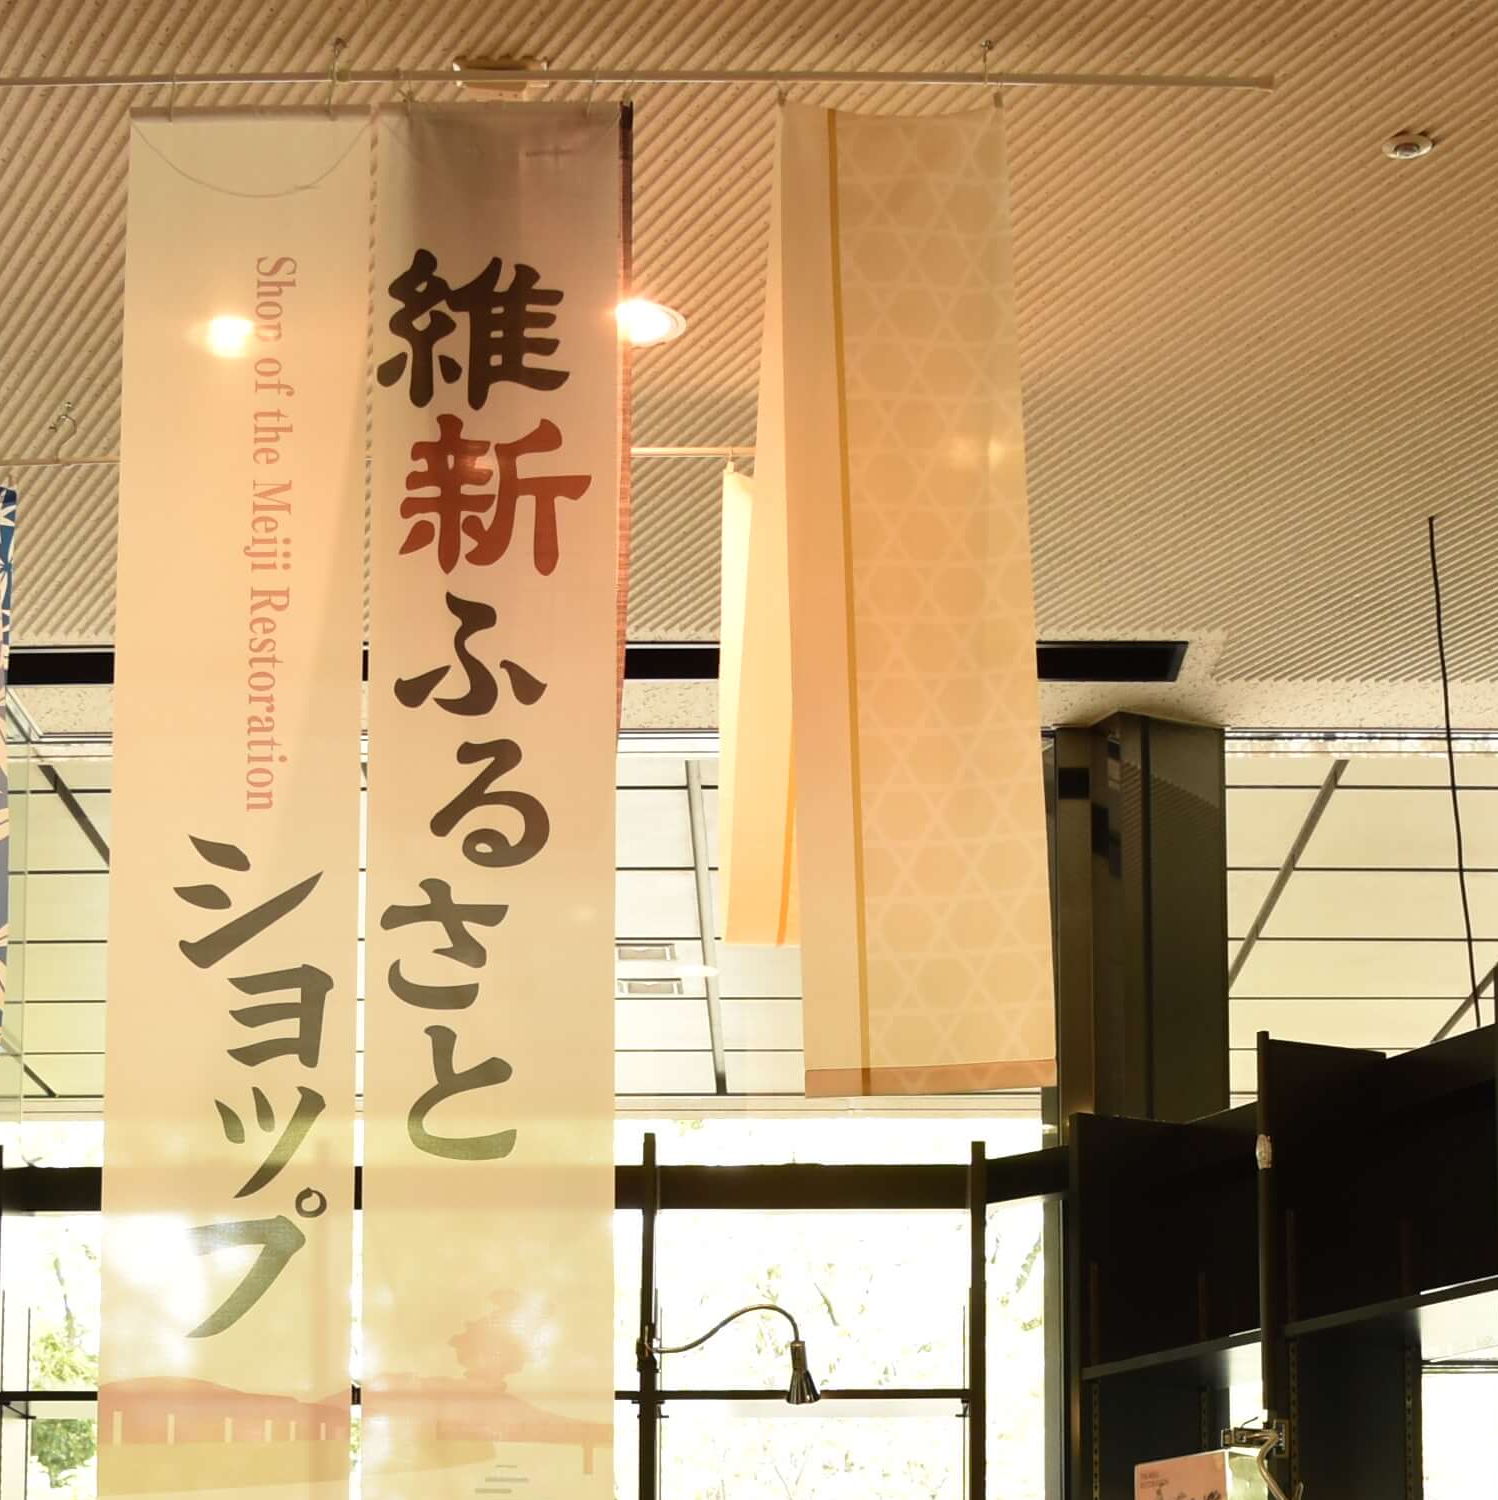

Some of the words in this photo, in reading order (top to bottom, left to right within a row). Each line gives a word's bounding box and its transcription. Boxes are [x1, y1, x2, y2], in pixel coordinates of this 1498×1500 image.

[255, 256, 298, 342] Shop
[254, 357, 295, 396] of
[252, 408, 293, 464] the
[243, 479, 293, 571] Meiji
[246, 586, 291, 811] Restoration
[377, 249, 591, 1160] 維新ふるさと
[173, 834, 334, 1338] ショップ
